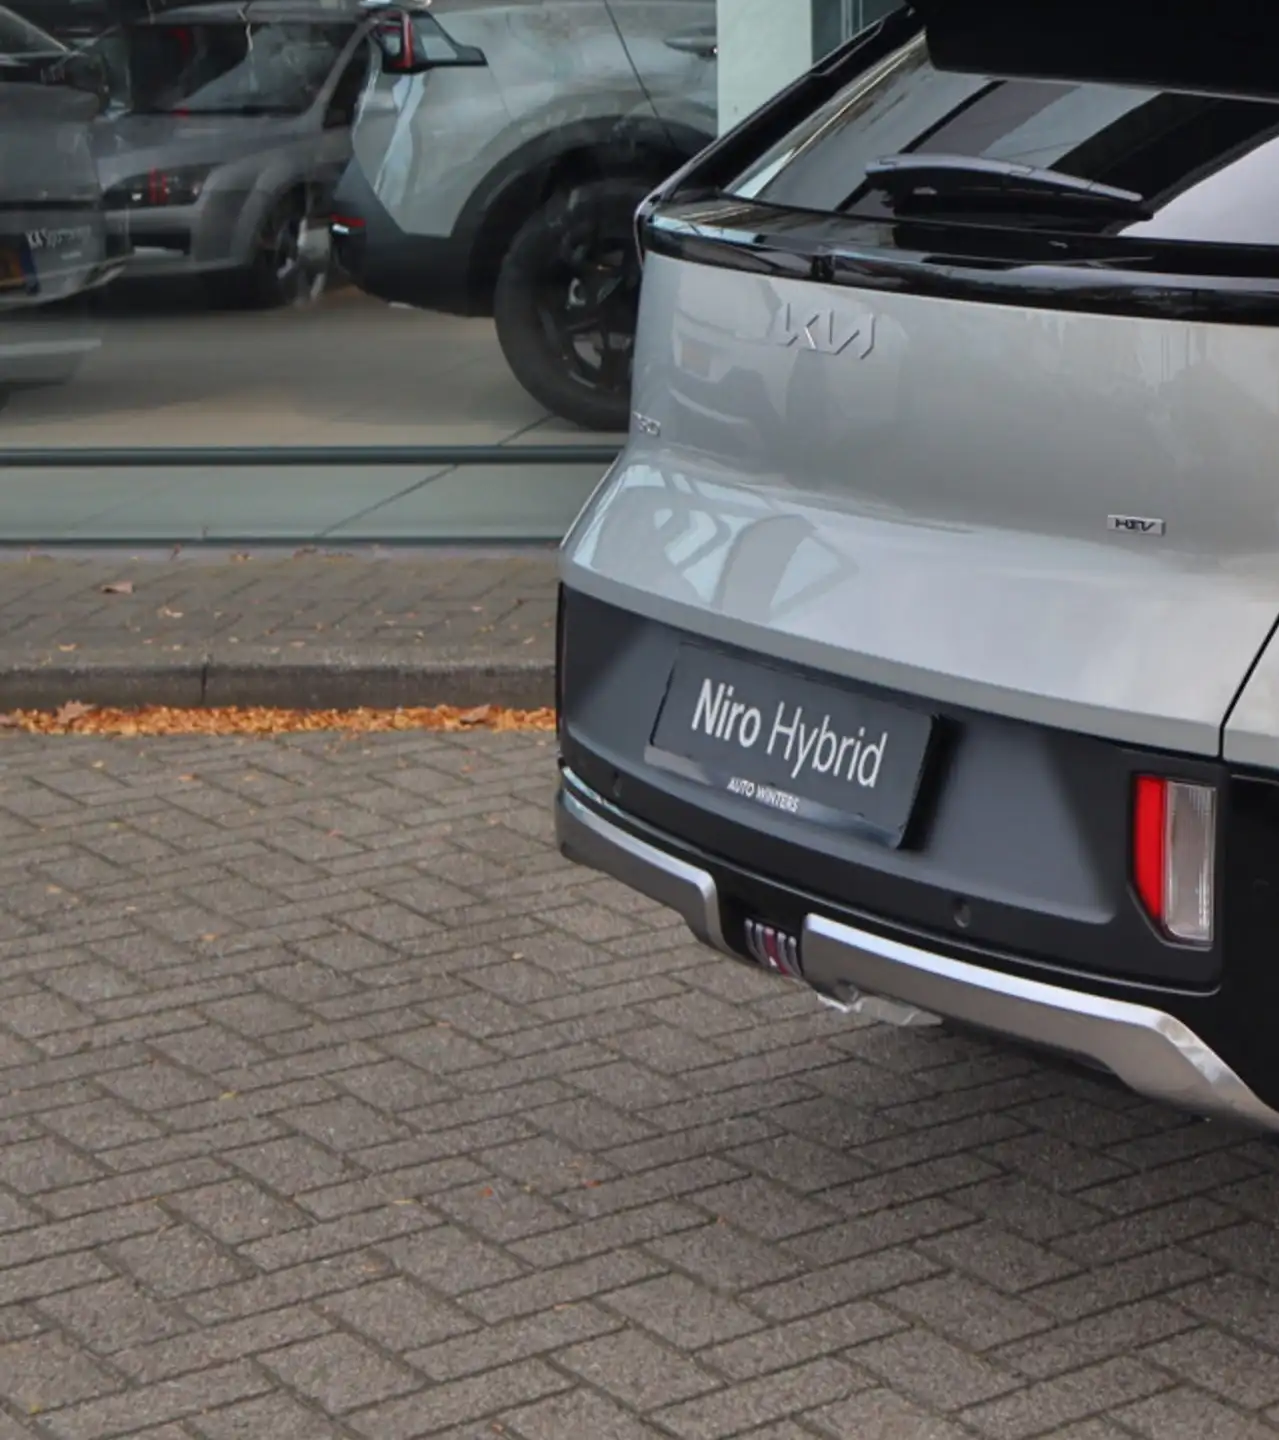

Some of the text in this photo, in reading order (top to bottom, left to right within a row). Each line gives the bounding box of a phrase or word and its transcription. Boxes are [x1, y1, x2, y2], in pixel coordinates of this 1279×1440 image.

[775, 302, 877, 360] KIA
[691, 678, 888, 788] Niro Hybrid
[727, 776, 799, 813] AUTO WINTERS
